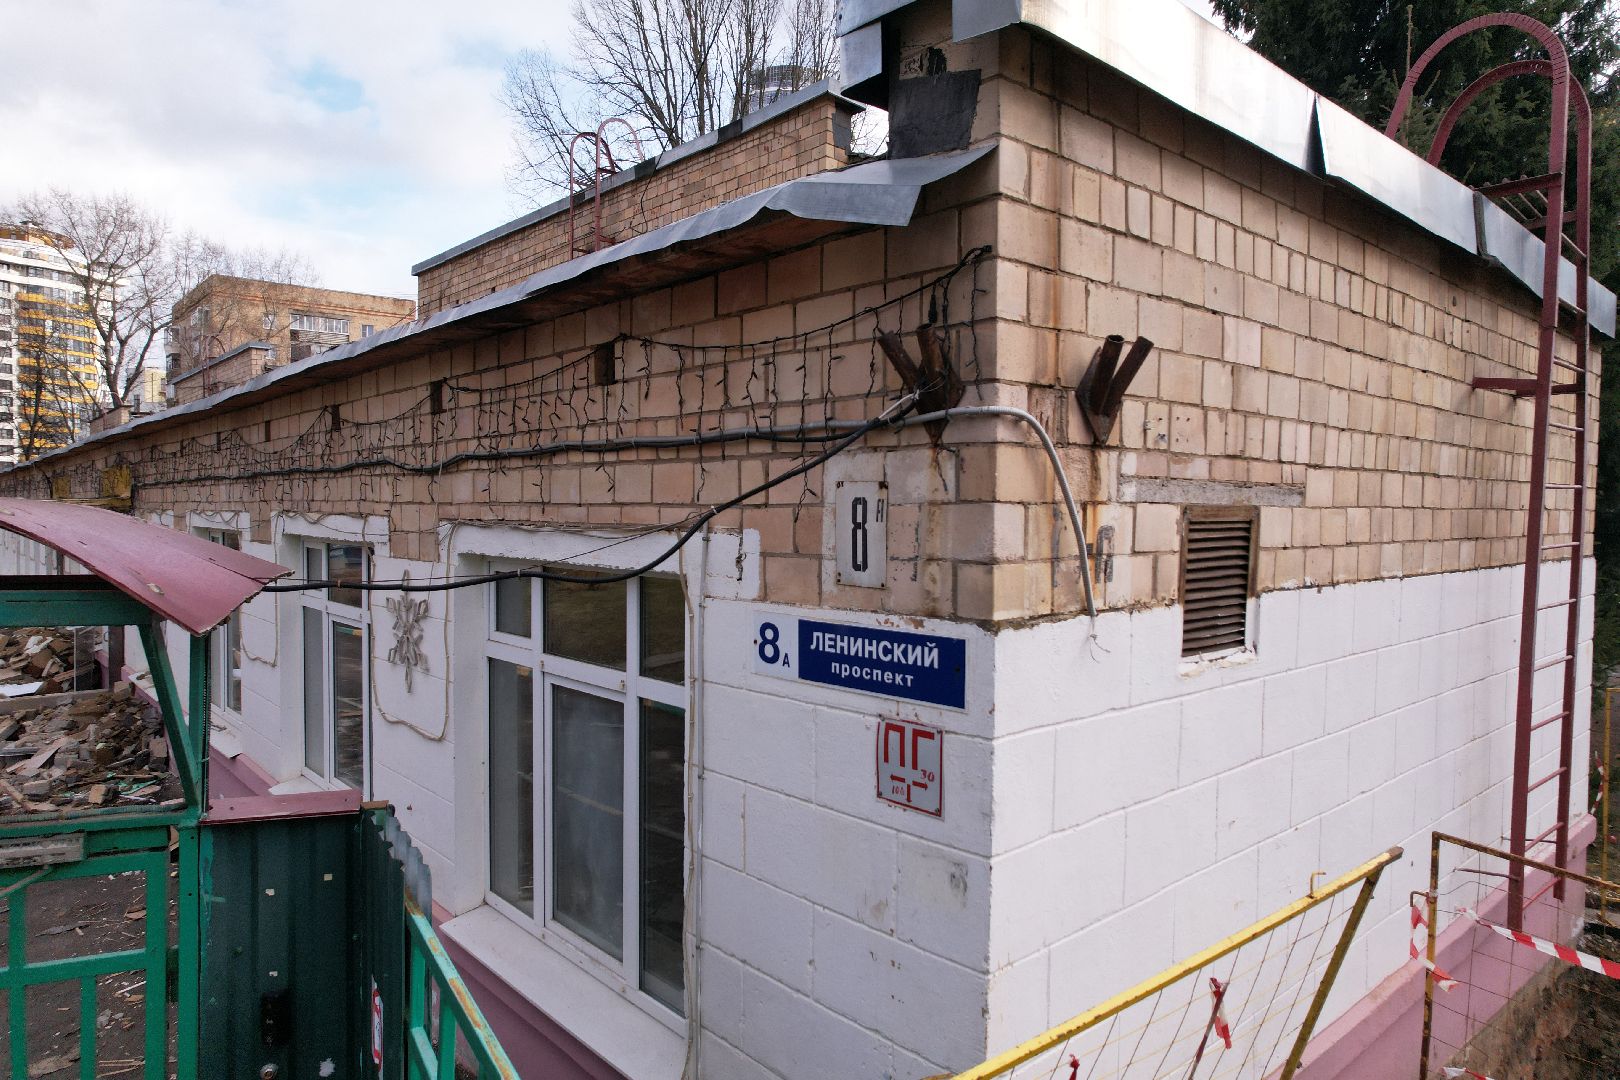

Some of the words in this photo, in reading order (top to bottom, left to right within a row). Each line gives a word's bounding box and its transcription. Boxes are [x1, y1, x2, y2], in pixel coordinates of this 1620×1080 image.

[810, 631, 939, 669] ЛЕНИНСКИЙ
[831, 661, 914, 687] проспект
[883, 722, 935, 770] ПГ
